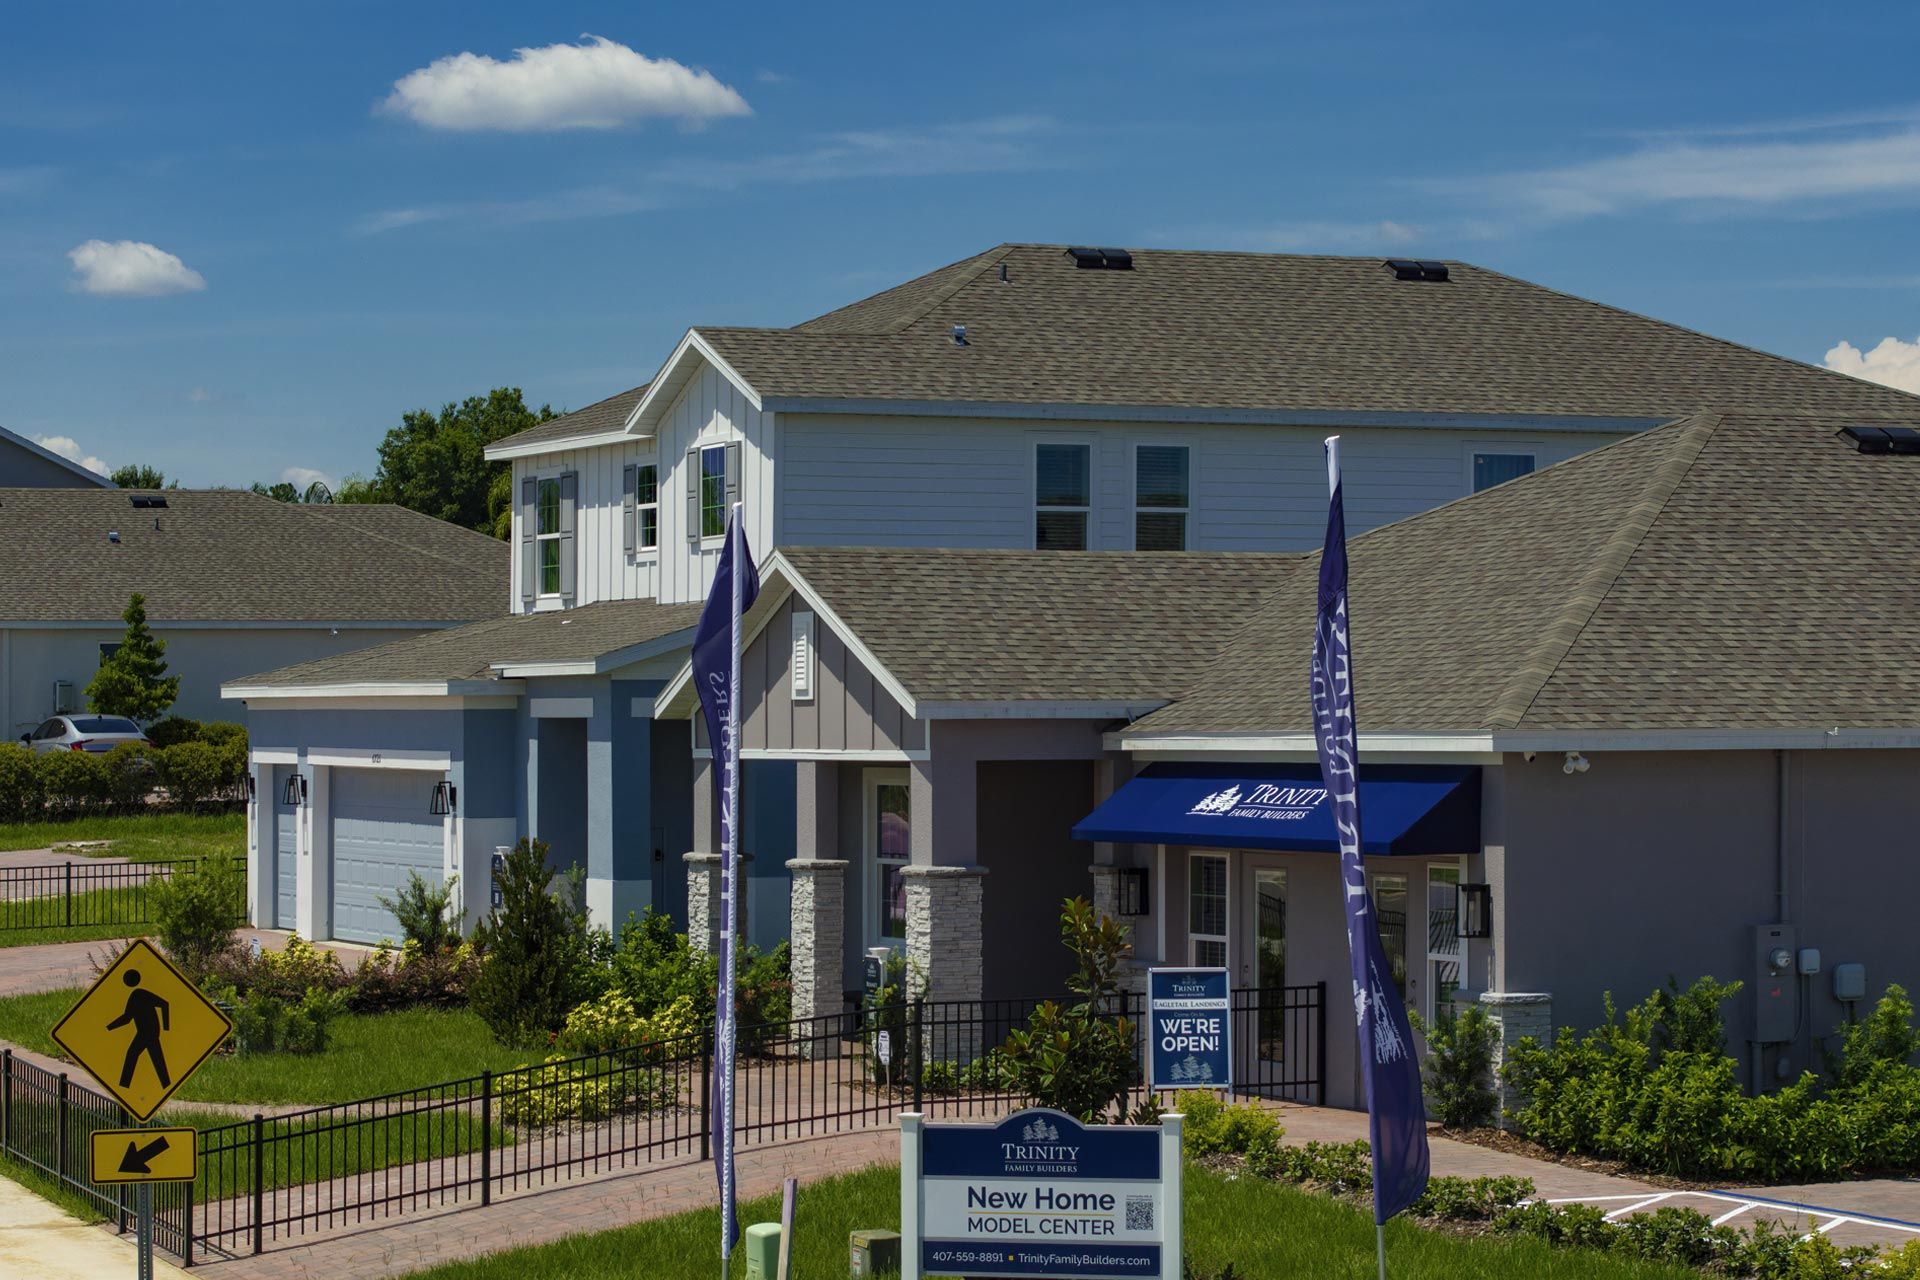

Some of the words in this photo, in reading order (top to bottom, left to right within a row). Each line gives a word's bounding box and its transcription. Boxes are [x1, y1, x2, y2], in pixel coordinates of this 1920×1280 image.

[1244, 784, 1328, 805] TRINITY
[1228, 809, 1263, 818] FAMILY
[1262, 810, 1310, 819] BUILDERS
[1172, 984, 1206, 992] TRINITY
[1160, 1018, 1220, 1034] WE'RE
[1162, 1036, 1219, 1051] OPEN!
[1001, 1142, 1080, 1160] TRINITY
[1004, 1164, 1035, 1172] FAMILY
[1036, 1164, 1078, 1173] BUILDERS
[967, 1186, 1027, 1209] New
[1035, 1187, 1116, 1211] Home
[968, 1217, 1035, 1234] MODEL
[1039, 1218, 1115, 1236] CENTER
[932, 1251, 1004, 1263] 407-559-8891
[1018, 1253, 1151, 1267] TrinityFamilyBuilders.com
